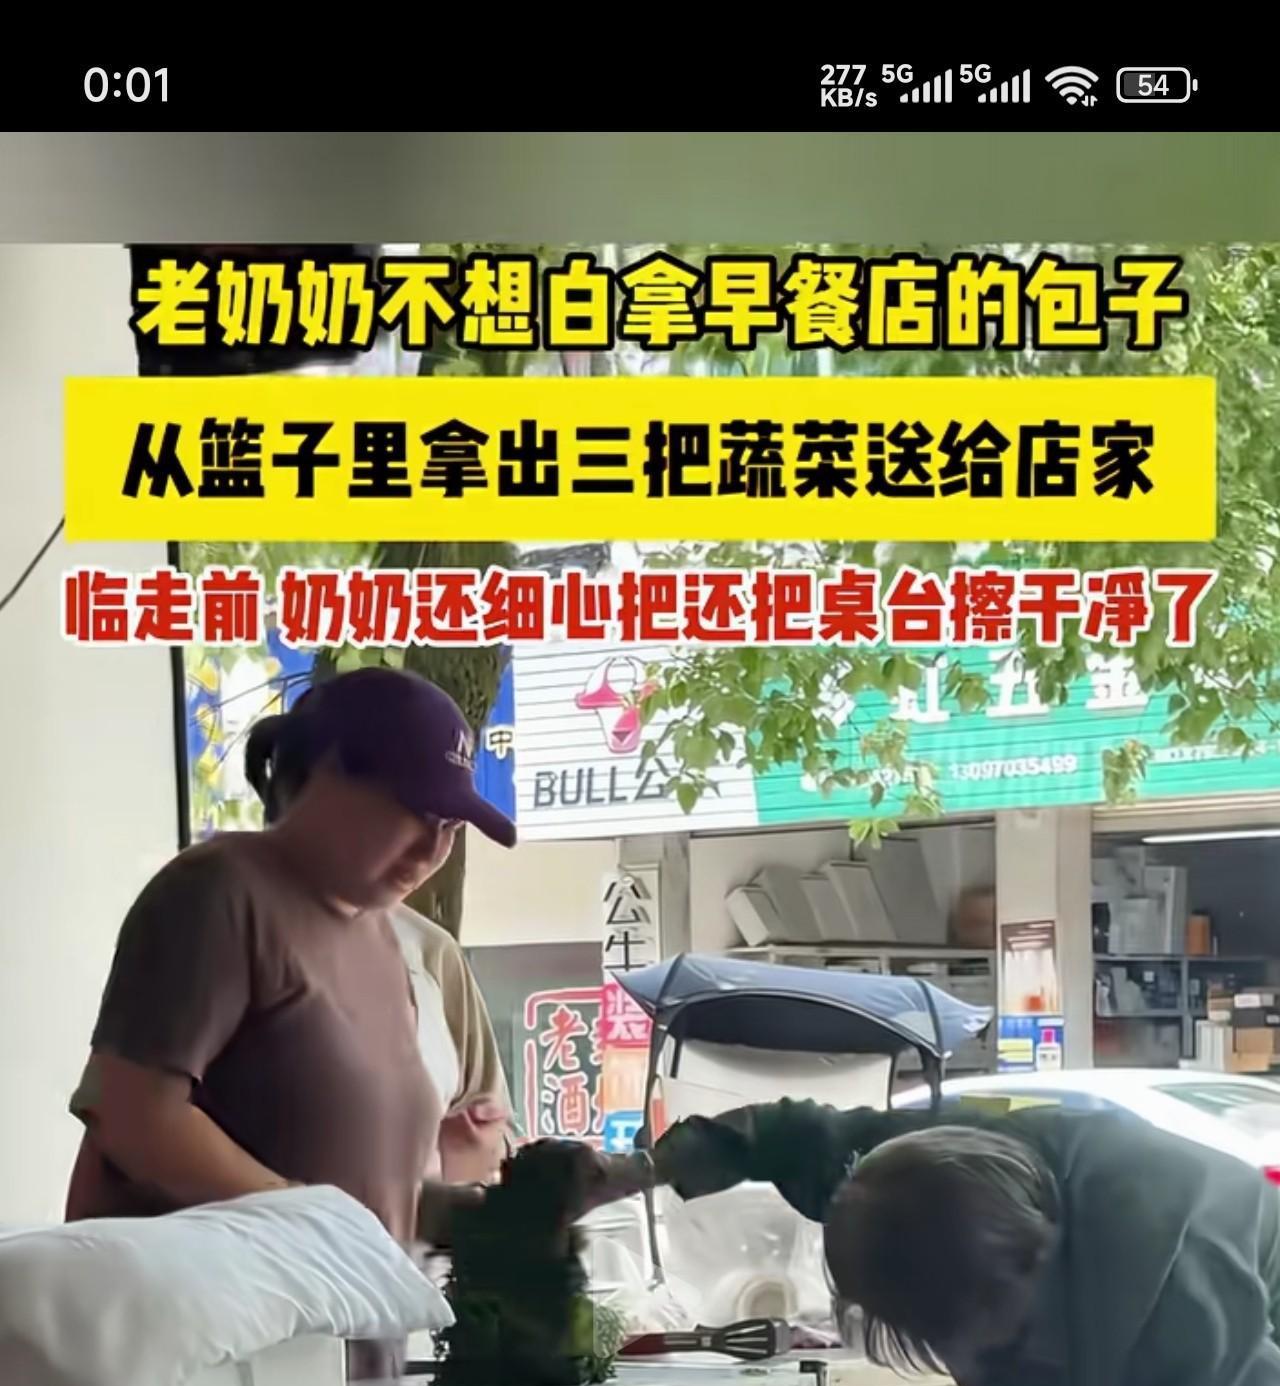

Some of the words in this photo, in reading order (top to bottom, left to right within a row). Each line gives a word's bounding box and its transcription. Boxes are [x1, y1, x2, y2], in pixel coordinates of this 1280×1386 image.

[83, 66, 170, 103] 0:01
[820, 64, 867, 86] 277
[881, 63, 914, 84] 5G
[959, 63, 992, 84] 5G
[1137, 73, 1170, 97] 54
[820, 87, 878, 108] KB/s
[534, 766, 627, 807] BULL
